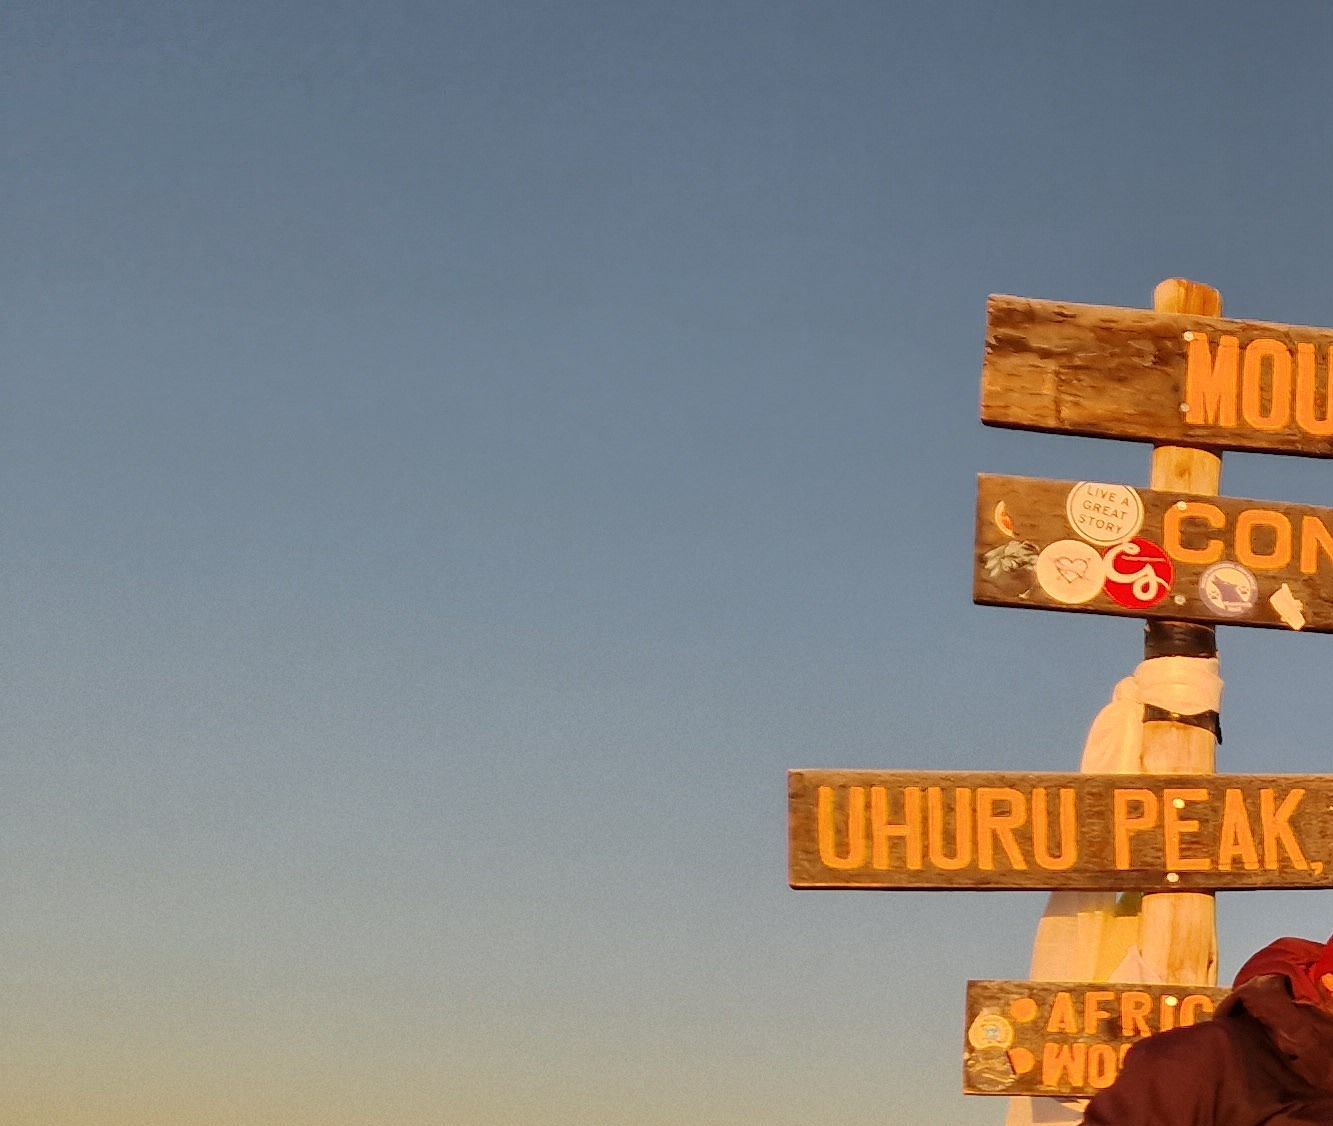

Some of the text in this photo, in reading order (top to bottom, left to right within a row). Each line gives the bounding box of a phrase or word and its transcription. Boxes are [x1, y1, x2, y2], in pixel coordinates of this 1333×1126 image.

[1087, 486, 1130, 505] LIVE A
[1083, 500, 1128, 519] GREAT
[1078, 515, 1122, 534] STORY
[817, 786, 1078, 870] UHURU
[1113, 788, 1323, 876] PEAK,
